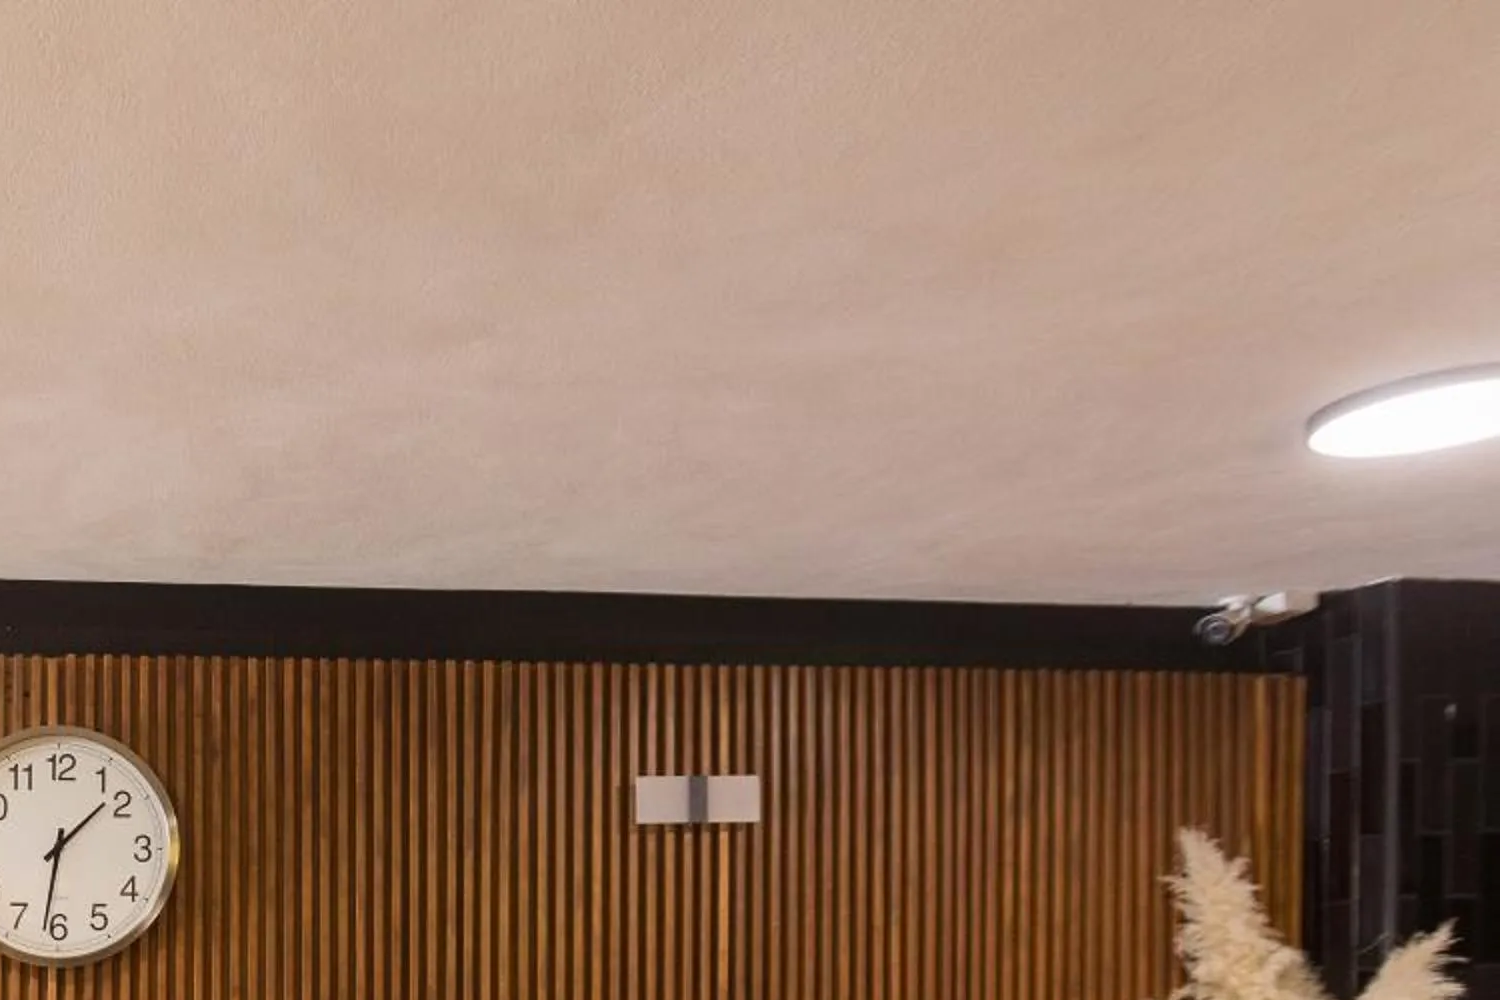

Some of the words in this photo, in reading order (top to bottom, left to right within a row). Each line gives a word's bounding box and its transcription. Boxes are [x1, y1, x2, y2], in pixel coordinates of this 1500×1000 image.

[8, 763, 33, 791] 11
[47, 753, 77, 781] 12
[95, 766, 106, 794] 1
[113, 790, 132, 818] 2
[133, 834, 153, 863] 3
[119, 875, 139, 903] 4
[9, 902, 29, 930] 7
[49, 913, 69, 941] 6
[90, 903, 109, 931] 5
